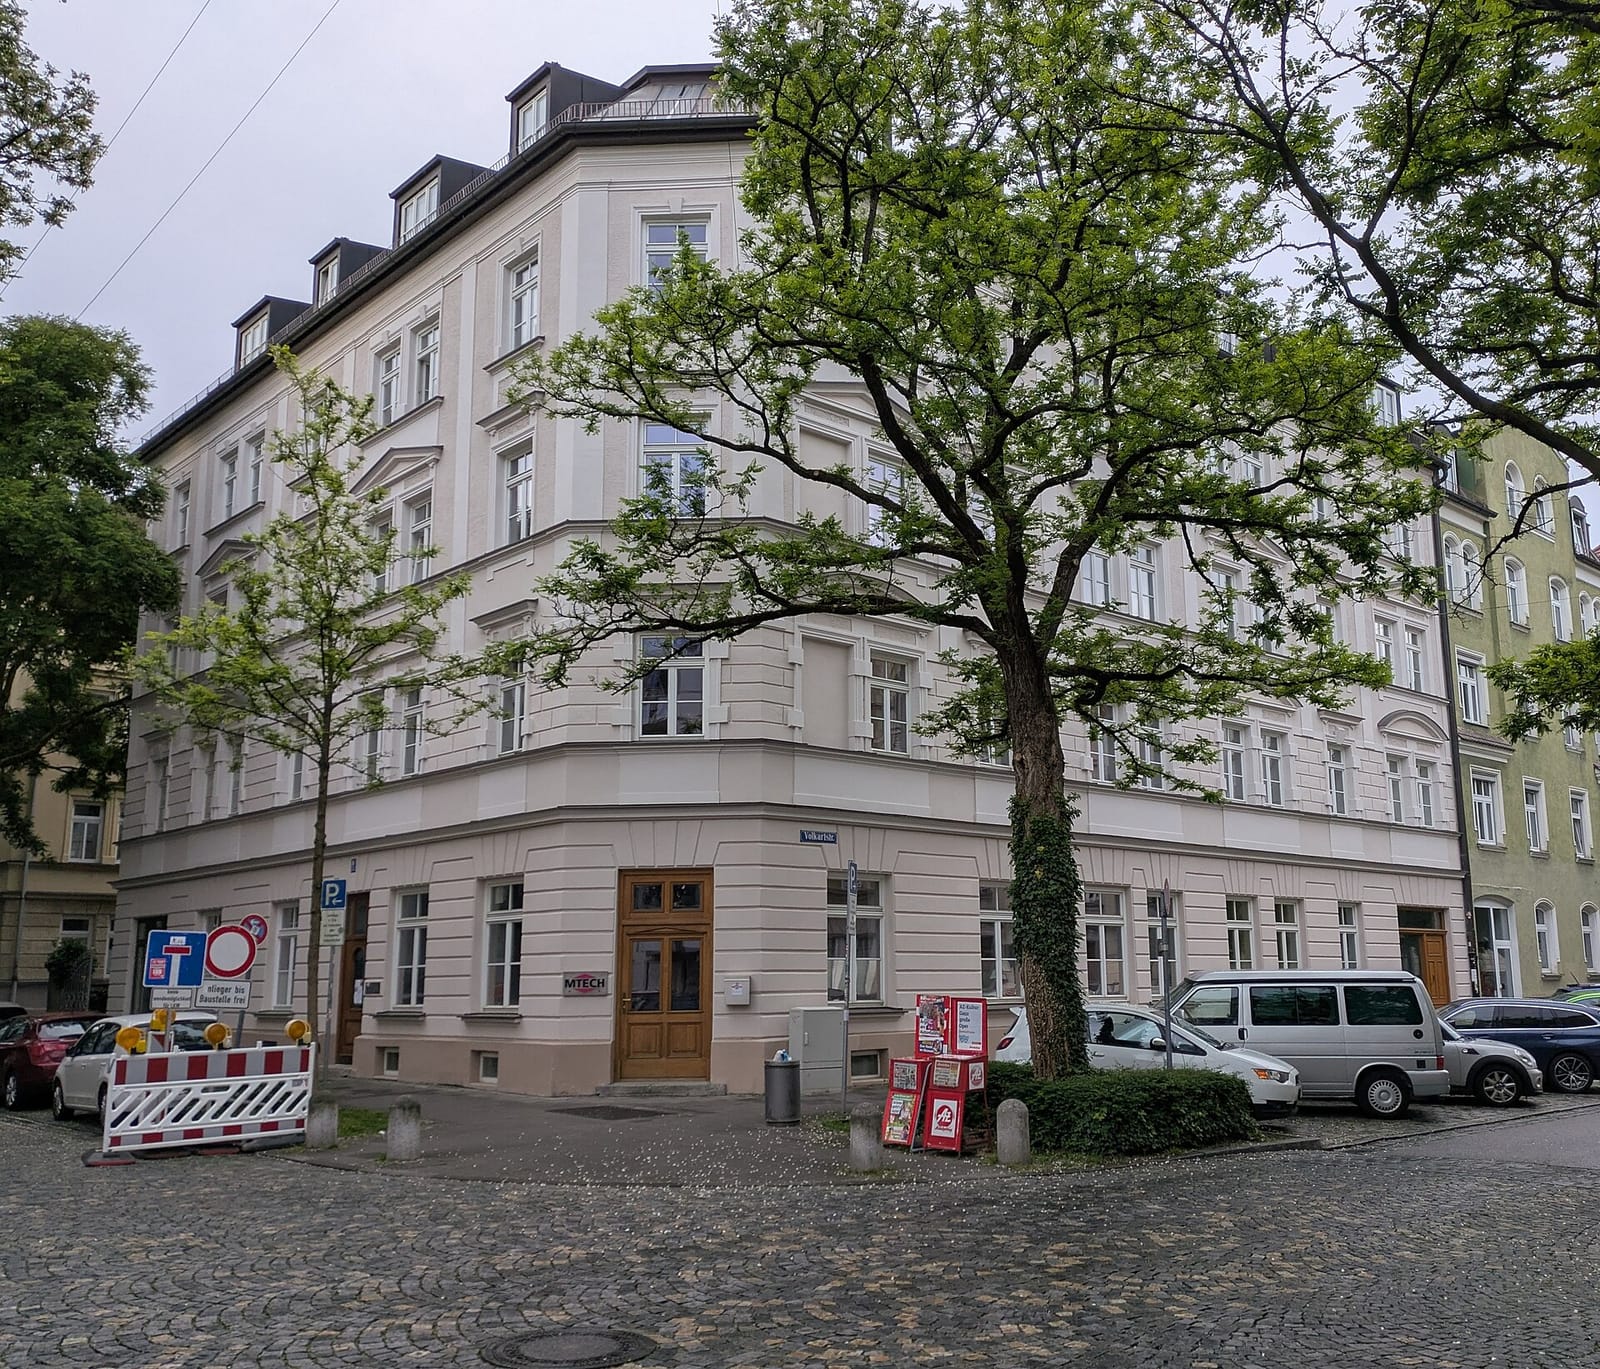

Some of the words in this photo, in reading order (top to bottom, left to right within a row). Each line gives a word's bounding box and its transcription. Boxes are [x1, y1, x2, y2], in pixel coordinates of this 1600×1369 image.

[325, 883, 339, 906] P
[564, 978, 605, 988] MTECH
[234, 985, 245, 994] bis
[199, 994, 231, 1004] Baustelle
[233, 995, 246, 1004] frei
[937, 1107, 952, 1122] AZ
